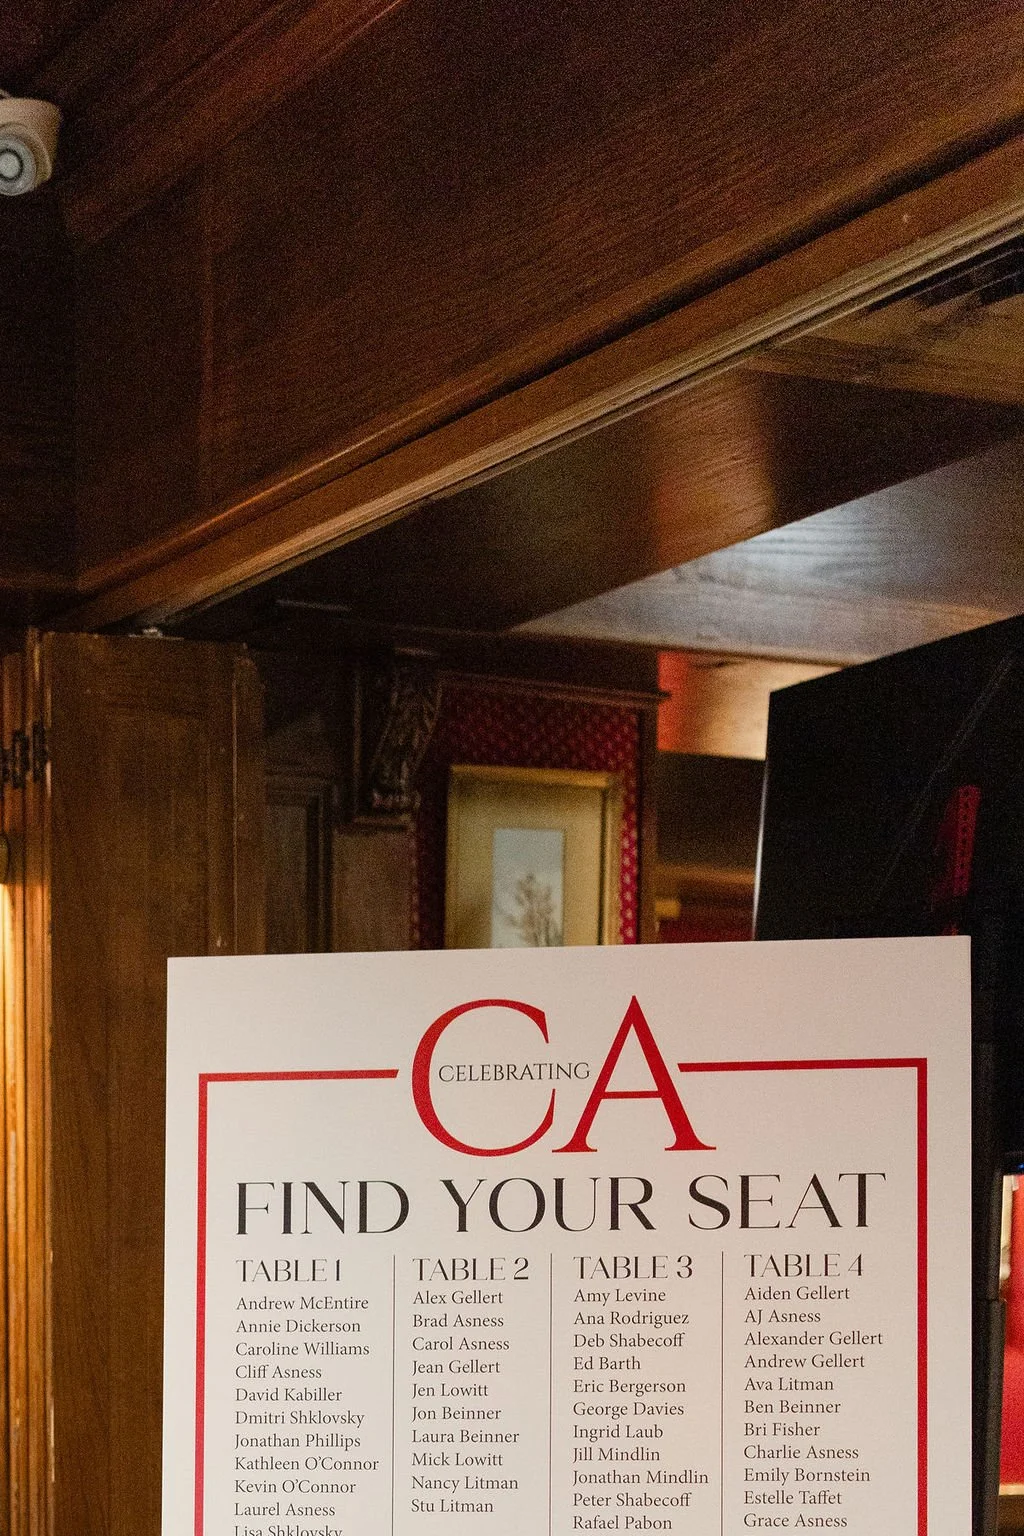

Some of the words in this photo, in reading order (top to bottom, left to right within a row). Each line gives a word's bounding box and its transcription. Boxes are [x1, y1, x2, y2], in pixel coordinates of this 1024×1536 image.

[411, 994, 717, 1157] CA
[438, 1061, 591, 1084] CELEBRATING
[236, 1181, 409, 1234] FIND
[440, 1177, 656, 1231] YOUR
[689, 1173, 886, 1229] SEAT
[235, 1258, 328, 1283] TABLE
[335, 1258, 341, 1282] 1
[412, 1257, 506, 1282] TABLE
[513, 1256, 529, 1281] 2
[572, 1255, 669, 1280] TABLE
[676, 1254, 693, 1279] 3
[743, 1253, 841, 1278] TABLE
[847, 1253, 864, 1277] 4
[412, 1289, 448, 1305] Alex
[451, 1289, 504, 1305] Gellert
[573, 1288, 611, 1307] Amy
[615, 1288, 666, 1303] Levine
[743, 1285, 791, 1301] Aiden
[796, 1284, 850, 1301] Gellert
[236, 1295, 296, 1311] Andrew
[299, 1295, 369, 1310] McEntire
[235, 1319, 281, 1333] Annie
[285, 1318, 361, 1333] Dickerson
[412, 1312, 448, 1328] Brad
[452, 1313, 504, 1328] Asness
[573, 1311, 606, 1326] Ana
[609, 1309, 690, 1330] Rodriguez
[743, 1308, 763, 1326] AJ
[767, 1308, 822, 1323] Asness
[412, 1335, 454, 1351] Carol
[458, 1336, 510, 1351] Asness
[573, 1332, 605, 1348] Deb
[609, 1331, 686, 1348] Shabecoff
[743, 1330, 825, 1346] Alexander
[828, 1330, 884, 1346] Gellert
[235, 1341, 299, 1357] Caroline
[303, 1340, 370, 1356] Williams
[411, 1359, 444, 1377] Jean
[448, 1358, 501, 1375] Gellert
[573, 1355, 595, 1371] Ed
[598, 1355, 641, 1371] Barth
[743, 1353, 808, 1369] Andrew
[811, 1352, 865, 1369] Gellert
[235, 1363, 270, 1379] Cliff
[271, 1365, 322, 1379] Asness
[411, 1383, 436, 1400] Jen
[440, 1382, 489, 1397] Lowitt
[573, 1379, 605, 1393] Eric
[608, 1378, 687, 1398] Bergerson
[743, 1376, 774, 1391] Ava
[778, 1376, 834, 1392] Litman
[235, 1386, 280, 1402] David
[284, 1386, 343, 1402] Kabiller
[411, 1406, 437, 1423] Jon
[441, 1406, 502, 1420] Beinner
[572, 1401, 629, 1421] George
[632, 1401, 685, 1416] Davies
[743, 1399, 775, 1414] Ben
[778, 1399, 842, 1414] Beinner
[235, 1410, 285, 1425] Dmitri
[289, 1409, 366, 1429] Shklovsky
[411, 1429, 456, 1444] Laura
[459, 1429, 520, 1444] Beinner
[573, 1423, 621, 1444] Ingrid
[625, 1423, 664, 1439] Laub
[743, 1422, 767, 1437] Bri
[772, 1421, 821, 1437] Fisher
[234, 1432, 301, 1450] Jonathan
[304, 1432, 361, 1452] Phillips
[411, 1451, 451, 1467] Mick
[454, 1452, 504, 1467] Lowitt
[572, 1446, 593, 1464] Jill
[597, 1446, 661, 1462] Mindlin
[743, 1444, 801, 1460] Charlie
[805, 1445, 860, 1460] Asness
[234, 1455, 300, 1471] Kathleen
[304, 1455, 380, 1471] O'Connor
[411, 1475, 460, 1494] Nancy
[463, 1475, 519, 1490] Litman
[572, 1469, 641, 1487] Jonathan
[646, 1469, 709, 1485] Mindlin
[743, 1466, 791, 1487] Emily
[794, 1467, 871, 1483] Bornstein
[234, 1479, 277, 1494] Kevin
[281, 1478, 357, 1494] O'Connor
[411, 1498, 435, 1513] Stu
[439, 1498, 494, 1513] Litman
[572, 1492, 612, 1507] Peter
[615, 1491, 693, 1507] Shabecoff
[743, 1489, 794, 1505] Estelle
[798, 1489, 843, 1505] Taffet
[233, 1501, 280, 1517] Laurel
[284, 1502, 336, 1517] Asness
[572, 1514, 620, 1530] Rafael
[624, 1514, 673, 1530] Pabon
[743, 1512, 790, 1528] Grace
[793, 1513, 848, 1528] Asness
